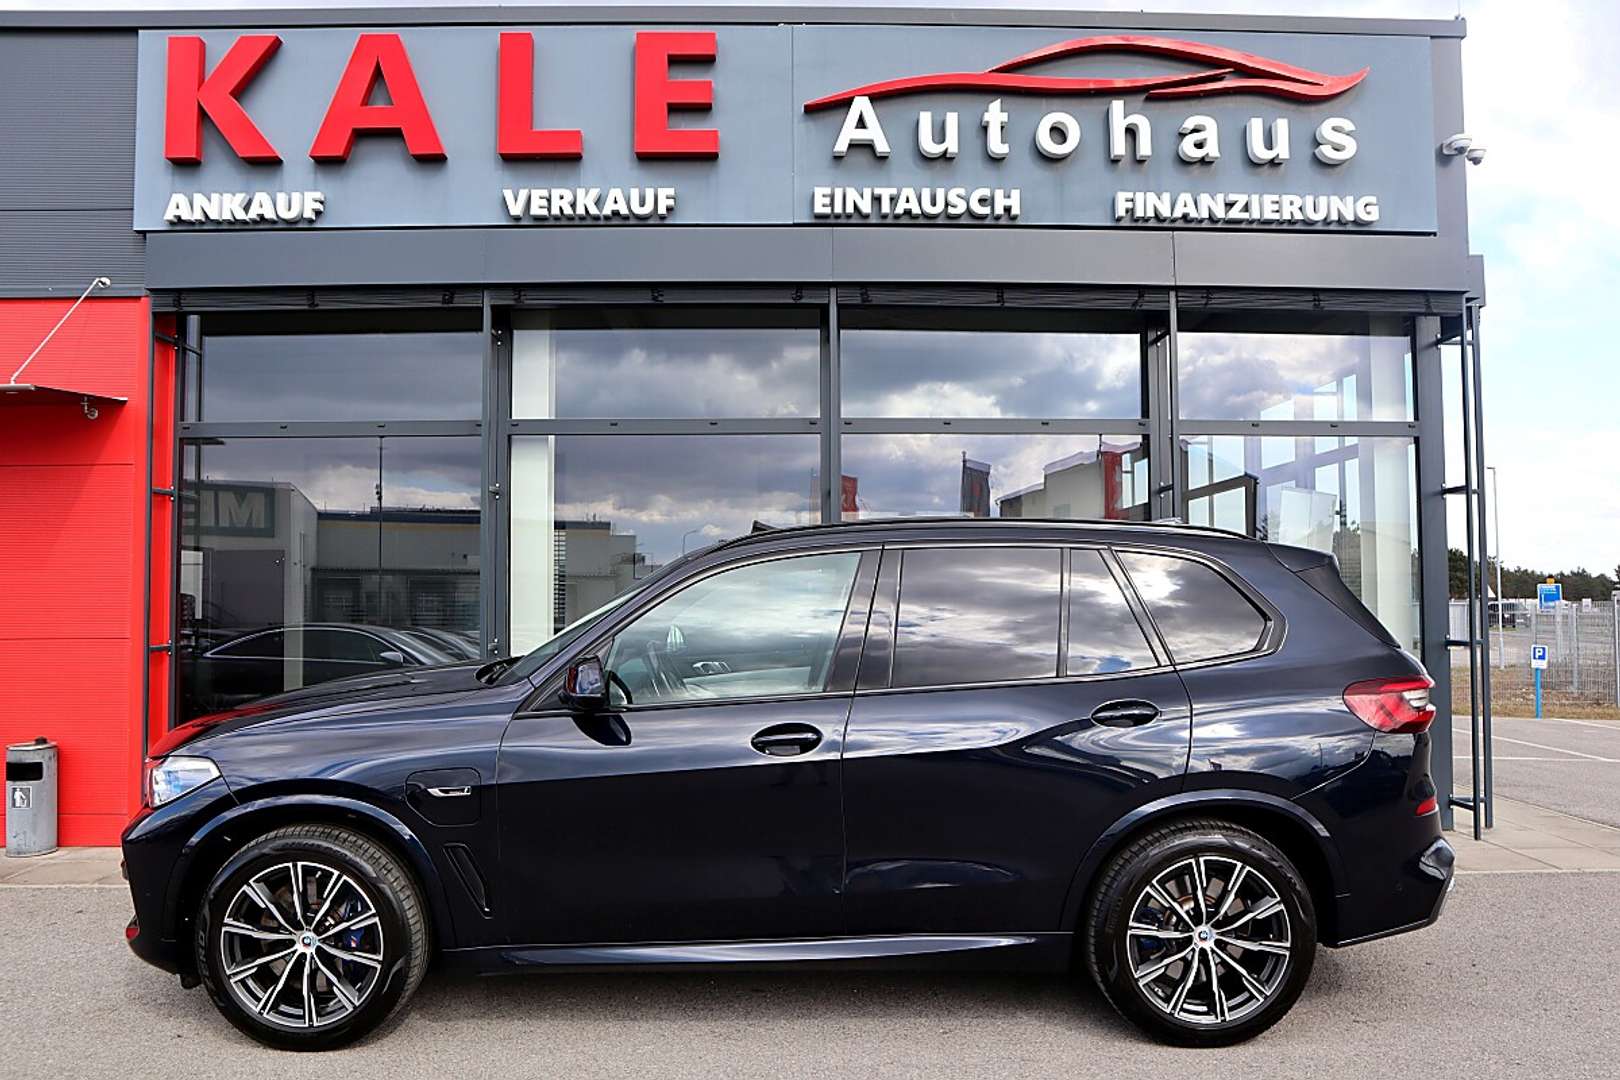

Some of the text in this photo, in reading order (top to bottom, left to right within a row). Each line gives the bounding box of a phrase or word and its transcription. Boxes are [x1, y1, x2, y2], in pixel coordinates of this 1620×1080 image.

[165, 32, 1358, 165] KALE Autohaus
[163, 191, 325, 223] ANKAUF
[502, 187, 676, 220] VERKAUF
[813, 186, 1021, 219] EINTAUSCH
[1114, 191, 1380, 224] FINANZIERUNG
